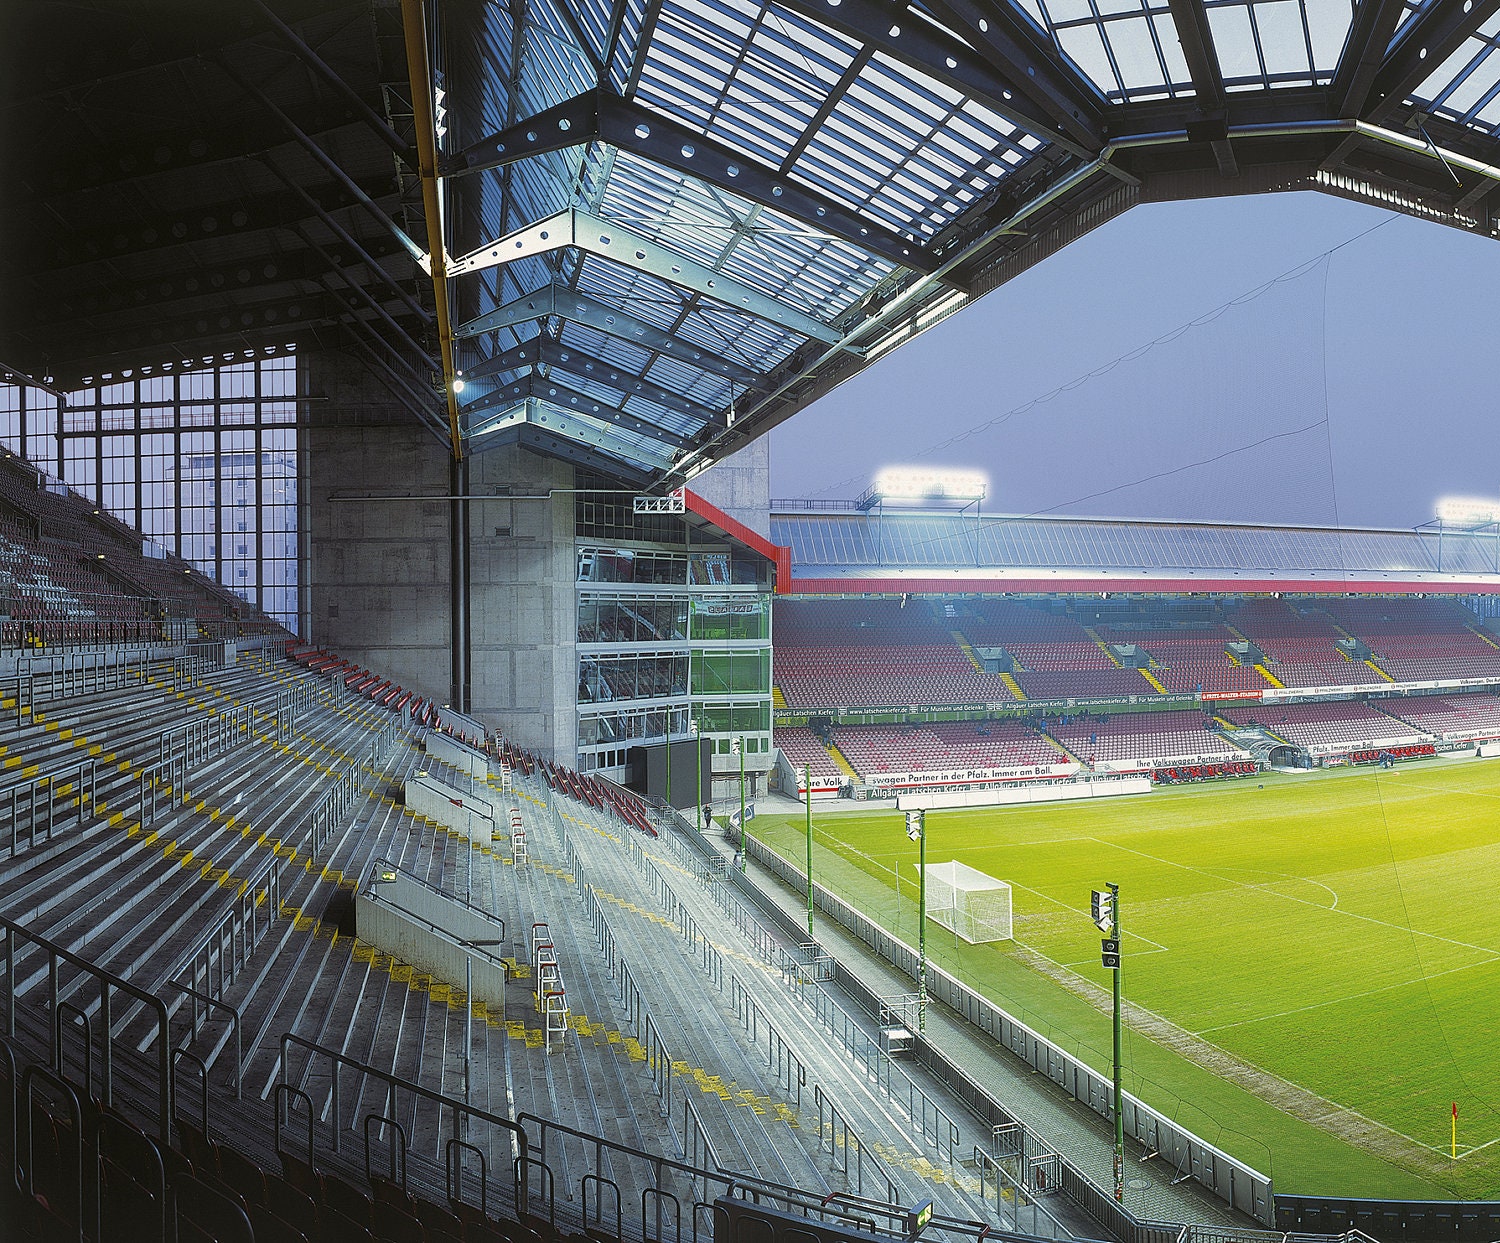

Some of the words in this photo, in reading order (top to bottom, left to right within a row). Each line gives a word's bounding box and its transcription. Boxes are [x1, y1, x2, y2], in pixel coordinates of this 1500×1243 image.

[849, 707, 907, 715] www.latschenkiefer.de
[1152, 757, 1196, 767] Volkswagen
[1197, 755, 1221, 763] Partner
[908, 774, 938, 783] Partner
[951, 772, 965, 780] der
[967, 771, 990, 779] Pfalz.
[992, 769, 1018, 778] Immer
[823, 777, 843, 787] Volk
[871, 788, 905, 799] Allgäuer
